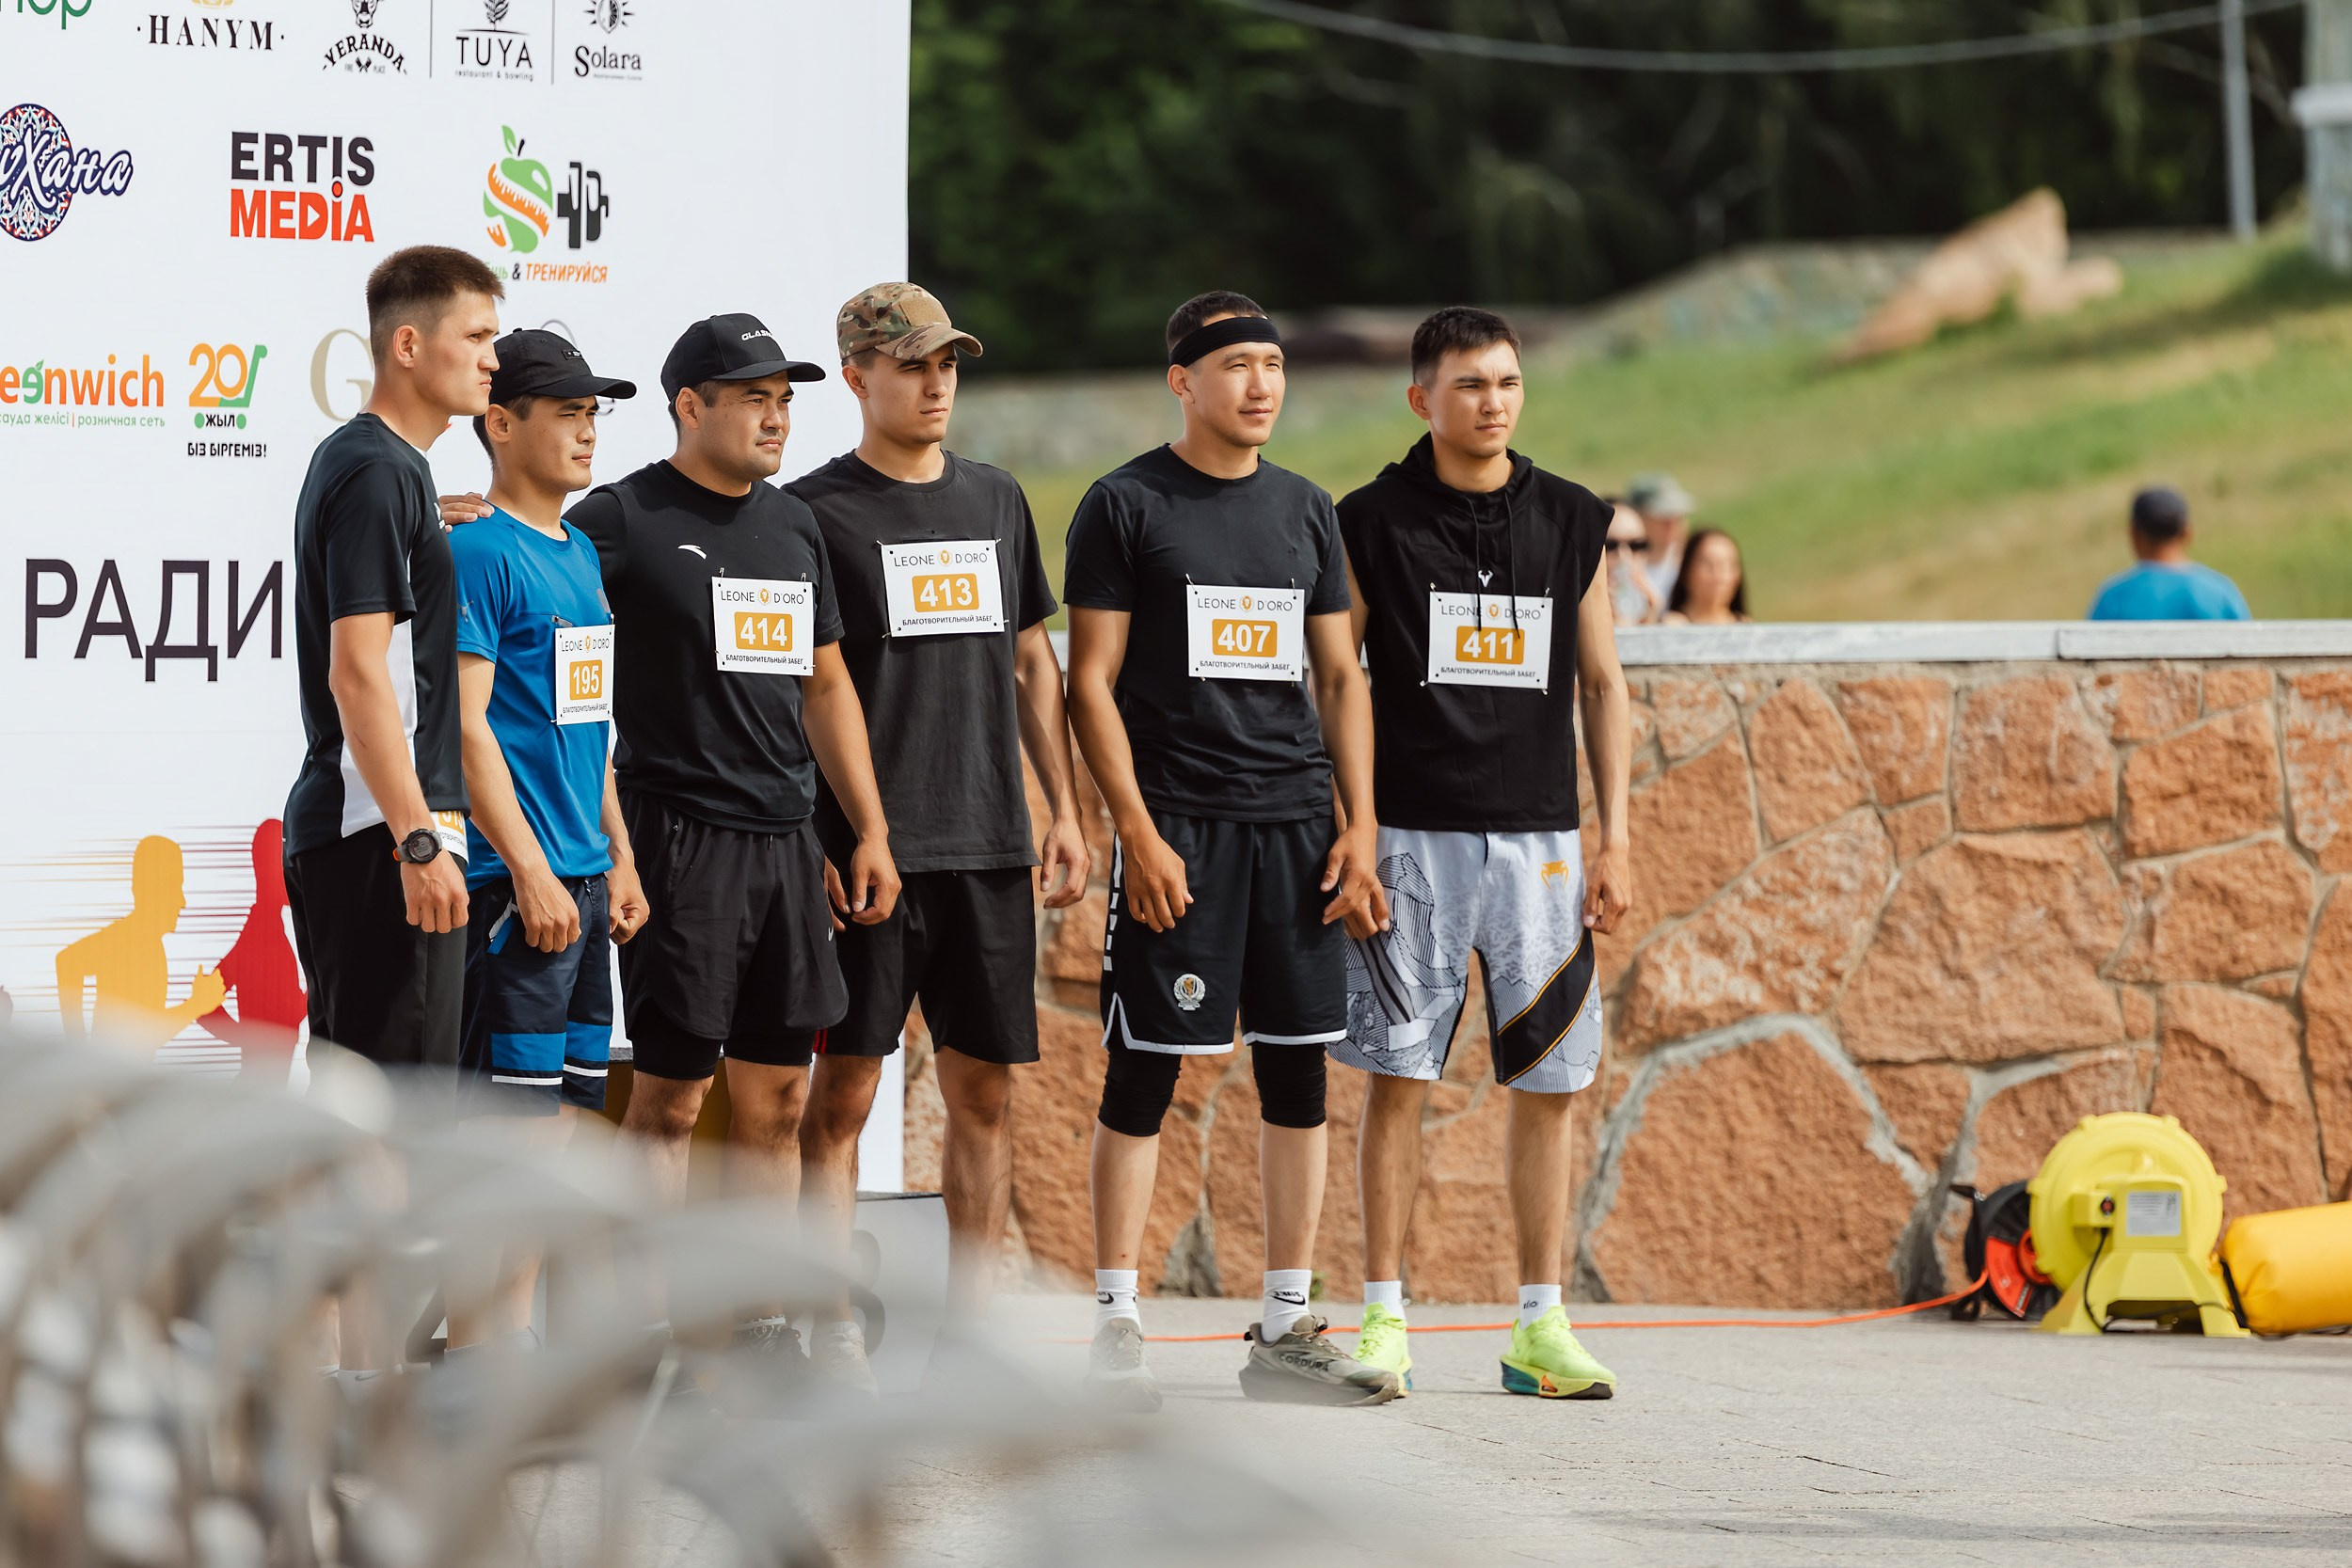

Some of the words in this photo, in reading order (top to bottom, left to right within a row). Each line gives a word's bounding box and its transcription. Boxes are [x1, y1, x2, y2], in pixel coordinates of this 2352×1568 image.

[456, 36, 532, 69] TUYA
[574, 45, 642, 77] Solara
[231, 131, 375, 186] ERTIS
[512, 262, 521, 280] &
[526, 261, 608, 283] ТРЕНИРУЙСЯ
[0, 413, 31, 427] ауда
[77, 414, 137, 429] розничная
[139, 416, 166, 428] сеть
[894, 554, 935, 567] LEONE
[721, 590, 755, 603] LEONE
[919, 578, 973, 607] 413
[1198, 598, 1236, 610] LEONE
[25, 558, 282, 682] РАДИ
[902, 614, 975, 626] БЛАГОТВОРИТЕЛЬНЫЙ
[739, 616, 787, 647] 414
[1217, 623, 1271, 653] 407
[561, 640, 583, 652] LEONE
[1462, 630, 1514, 660] 411
[725, 654, 787, 664] БЛАГОТВОРИТЕЛЬНЫЙ
[1200, 660, 1270, 670] БЛАГОТВОРИТЕЛЬНЫЙ
[573, 665, 599, 695] 195
[1440, 667, 1516, 676] БЛАГОТВОРИТЕЛЬНЫЙ
